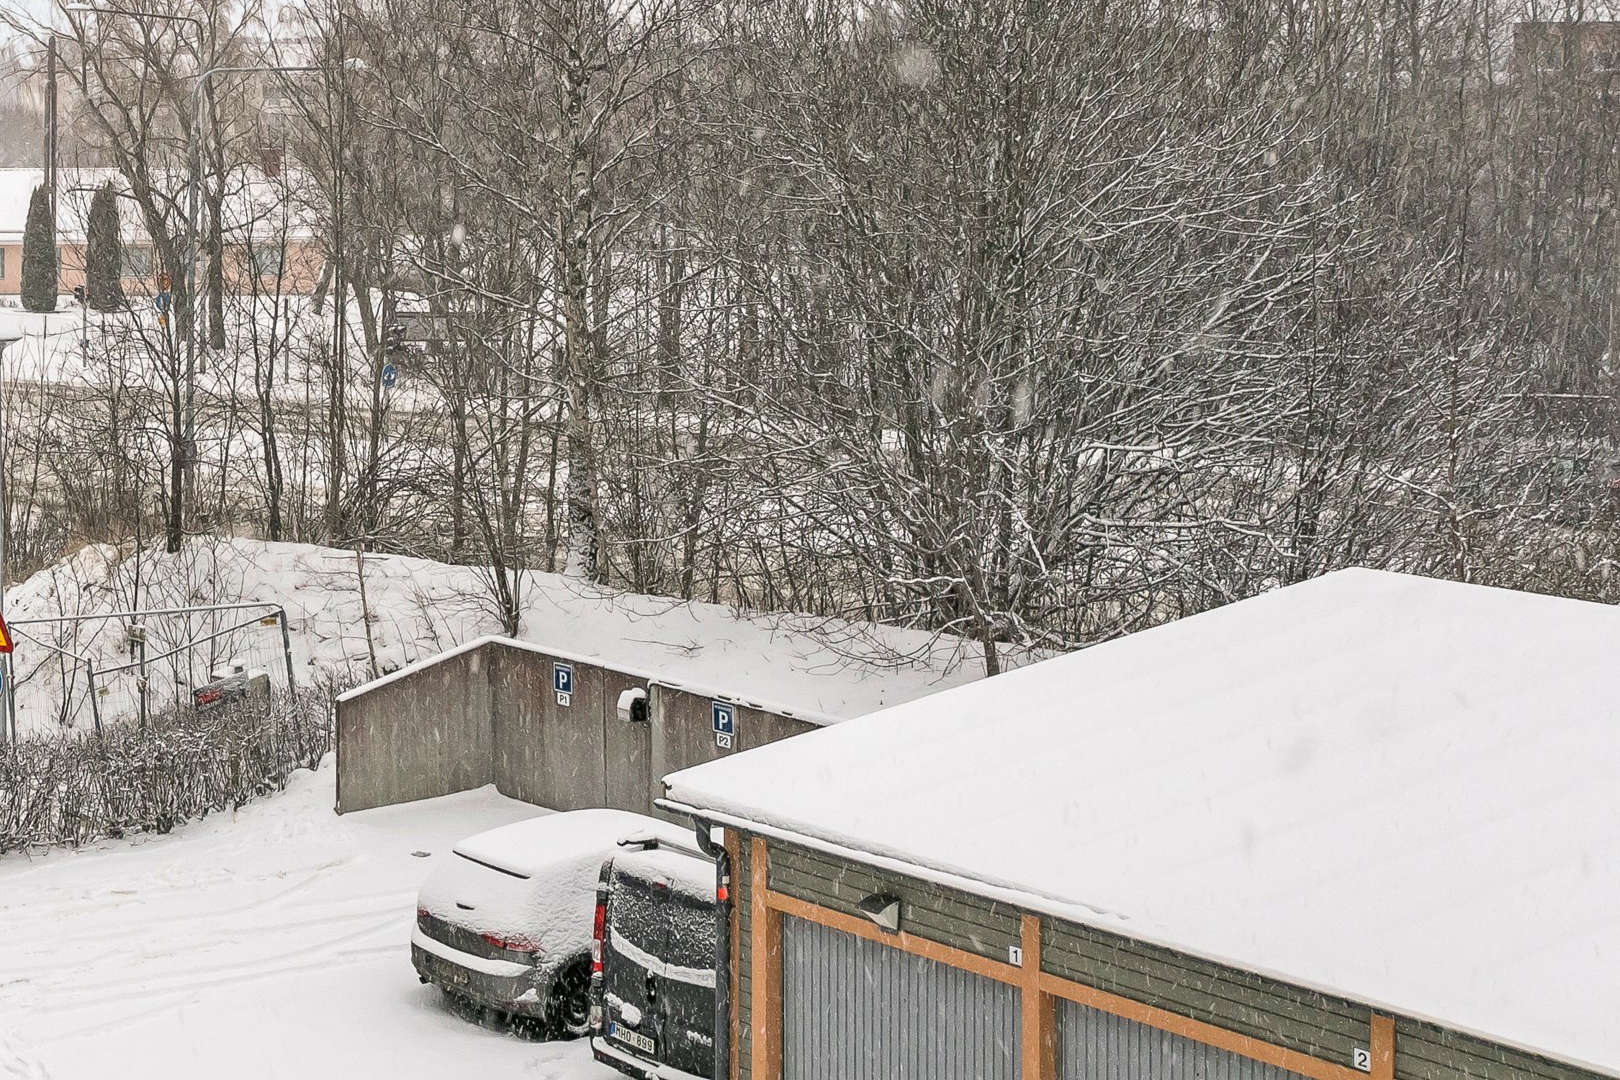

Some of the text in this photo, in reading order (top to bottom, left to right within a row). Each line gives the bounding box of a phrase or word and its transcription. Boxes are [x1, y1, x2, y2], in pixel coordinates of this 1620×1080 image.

[559, 671, 567, 689] P
[560, 695, 567, 704] P1
[719, 711, 728, 729] P
[719, 736, 728, 746] P2
[1012, 949, 1017, 962] 1
[637, 1033, 653, 1051] 899
[1358, 1052, 1367, 1068] 2
